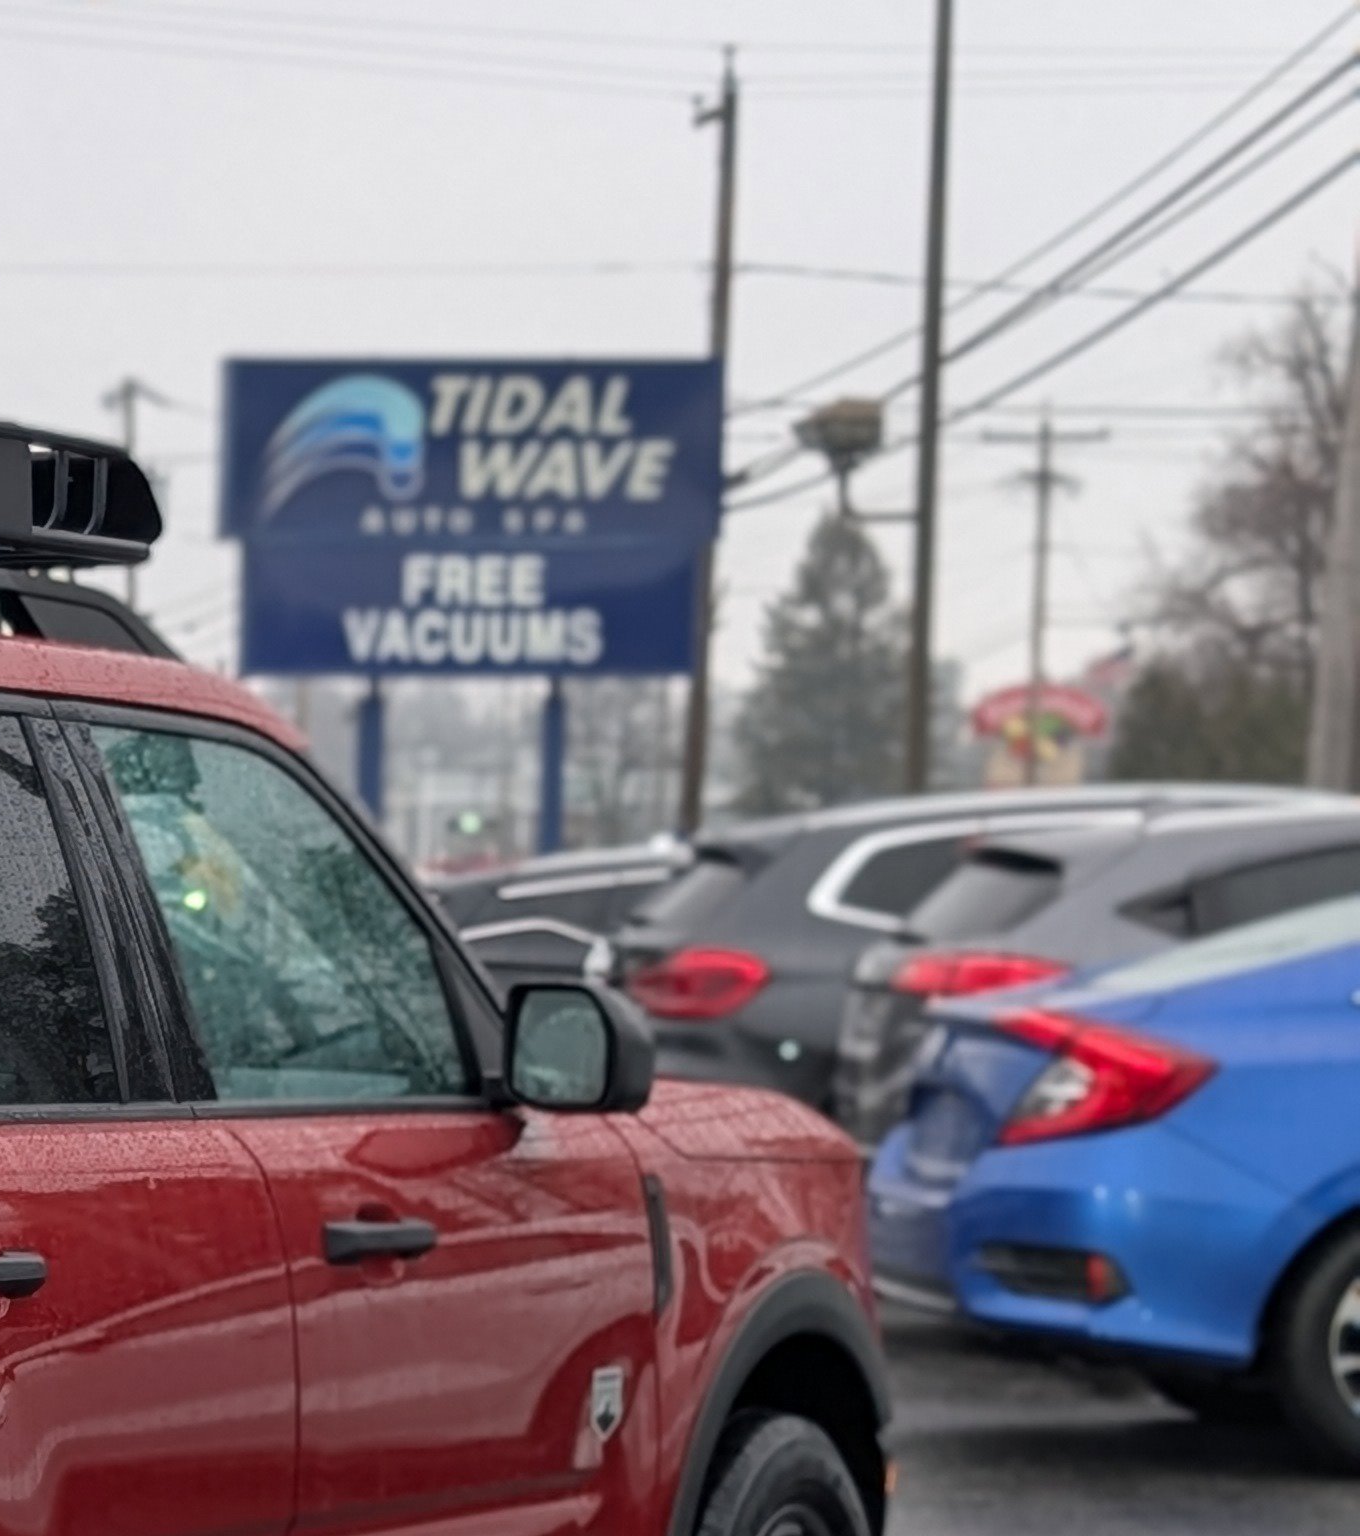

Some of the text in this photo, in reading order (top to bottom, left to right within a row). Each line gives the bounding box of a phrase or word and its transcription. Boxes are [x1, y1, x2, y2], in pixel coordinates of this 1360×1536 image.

[430, 375, 632, 437] TIDAL
[460, 439, 677, 500] WAVE
[402, 553, 545, 607] FREE
[342, 608, 603, 664] VACUUMS
